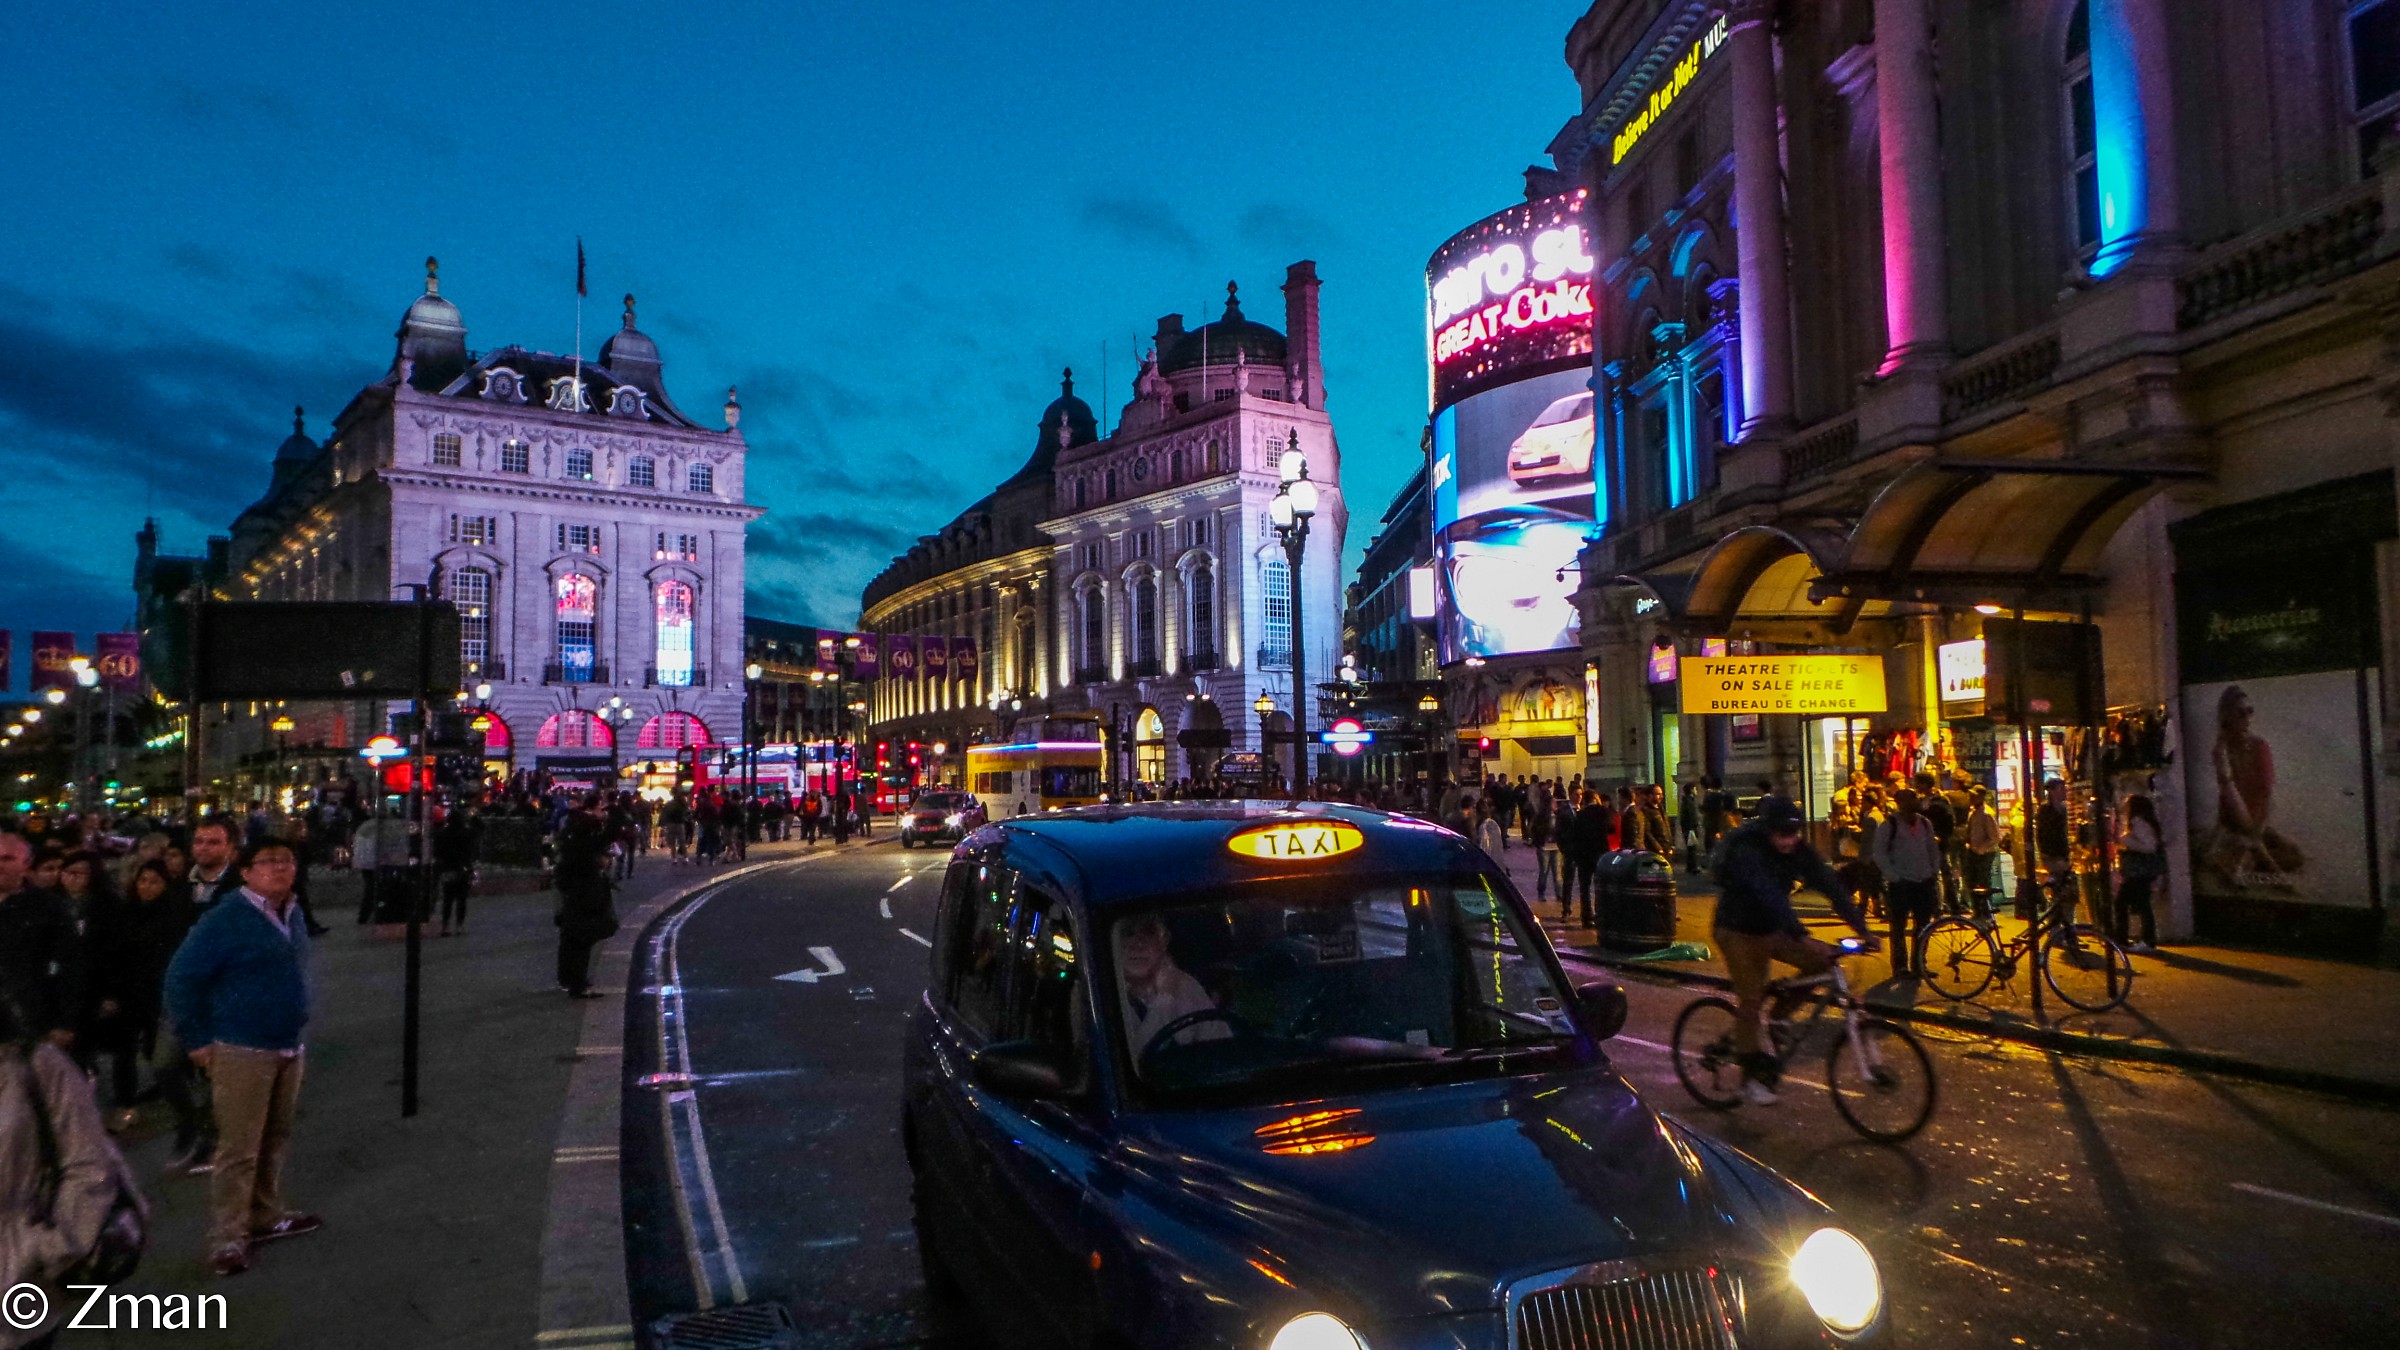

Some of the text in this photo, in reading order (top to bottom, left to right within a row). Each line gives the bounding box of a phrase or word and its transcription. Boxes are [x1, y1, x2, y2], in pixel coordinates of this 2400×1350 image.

[1613, 110, 1649, 165] Believe
[1660, 81, 1673, 110] or
[1436, 304, 1502, 362] GREAT
[892, 650, 914, 669] 60
[1705, 664, 1780, 675] THEATRE
[1721, 680, 1844, 691] ON SALE HERE
[1711, 699, 1857, 709] BUREAU DE CHANGE
[1264, 831, 1341, 855] TAXI
